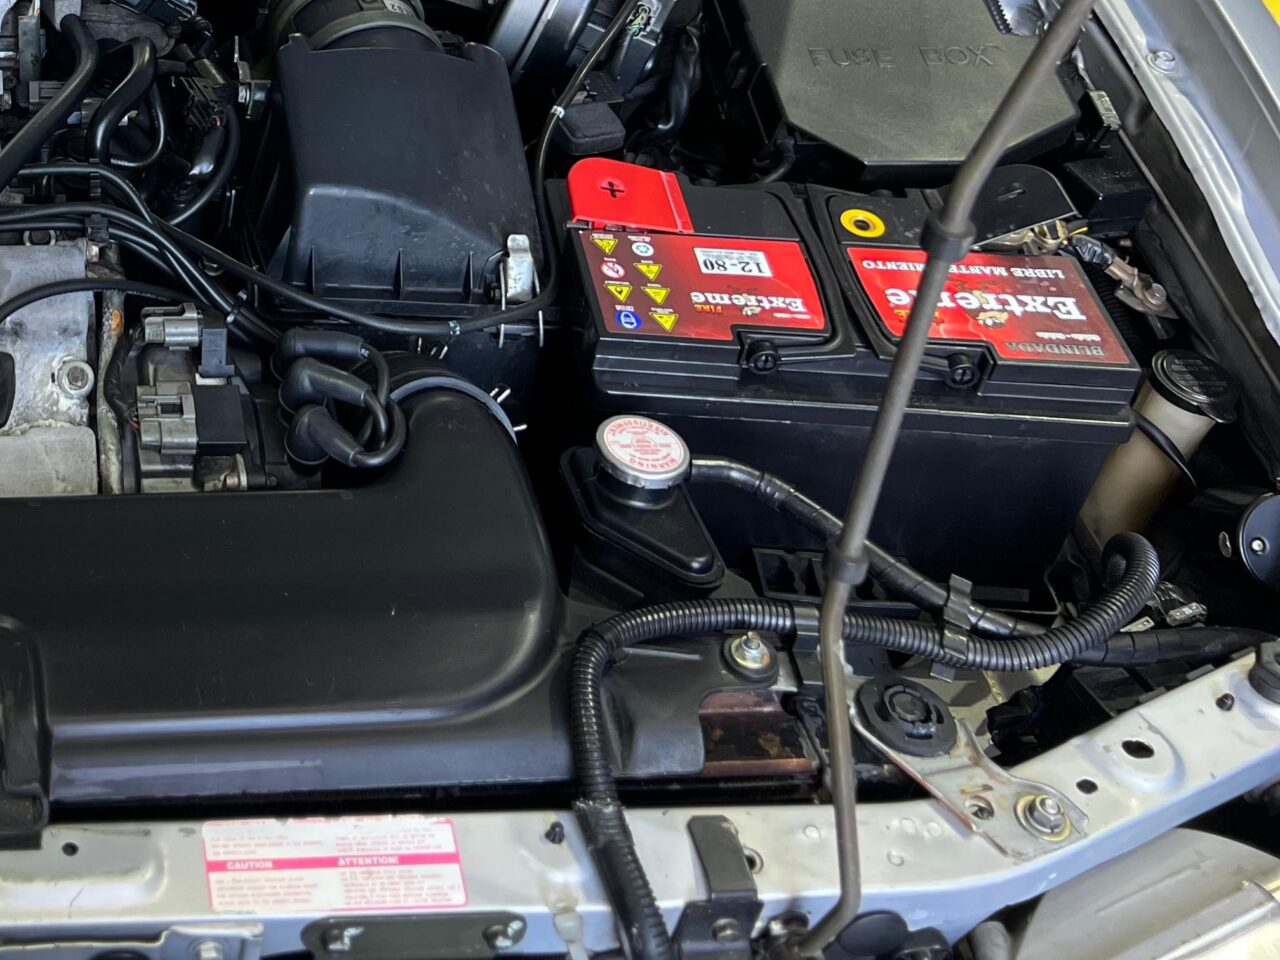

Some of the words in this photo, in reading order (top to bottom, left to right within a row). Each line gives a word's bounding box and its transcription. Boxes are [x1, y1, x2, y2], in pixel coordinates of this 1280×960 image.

[807, 46, 896, 69] FUSE
[918, 45, 995, 68] BOX
[703, 259, 765, 274] 12-80
[861, 260, 1009, 277] MANTEMIENTO
[1010, 266, 1065, 279] LIBRE
[690, 292, 807, 312] Extreme
[1005, 341, 1105, 357] BLINDADA
[628, 456, 677, 470] WARNING
[226, 860, 273, 871] CAUTION
